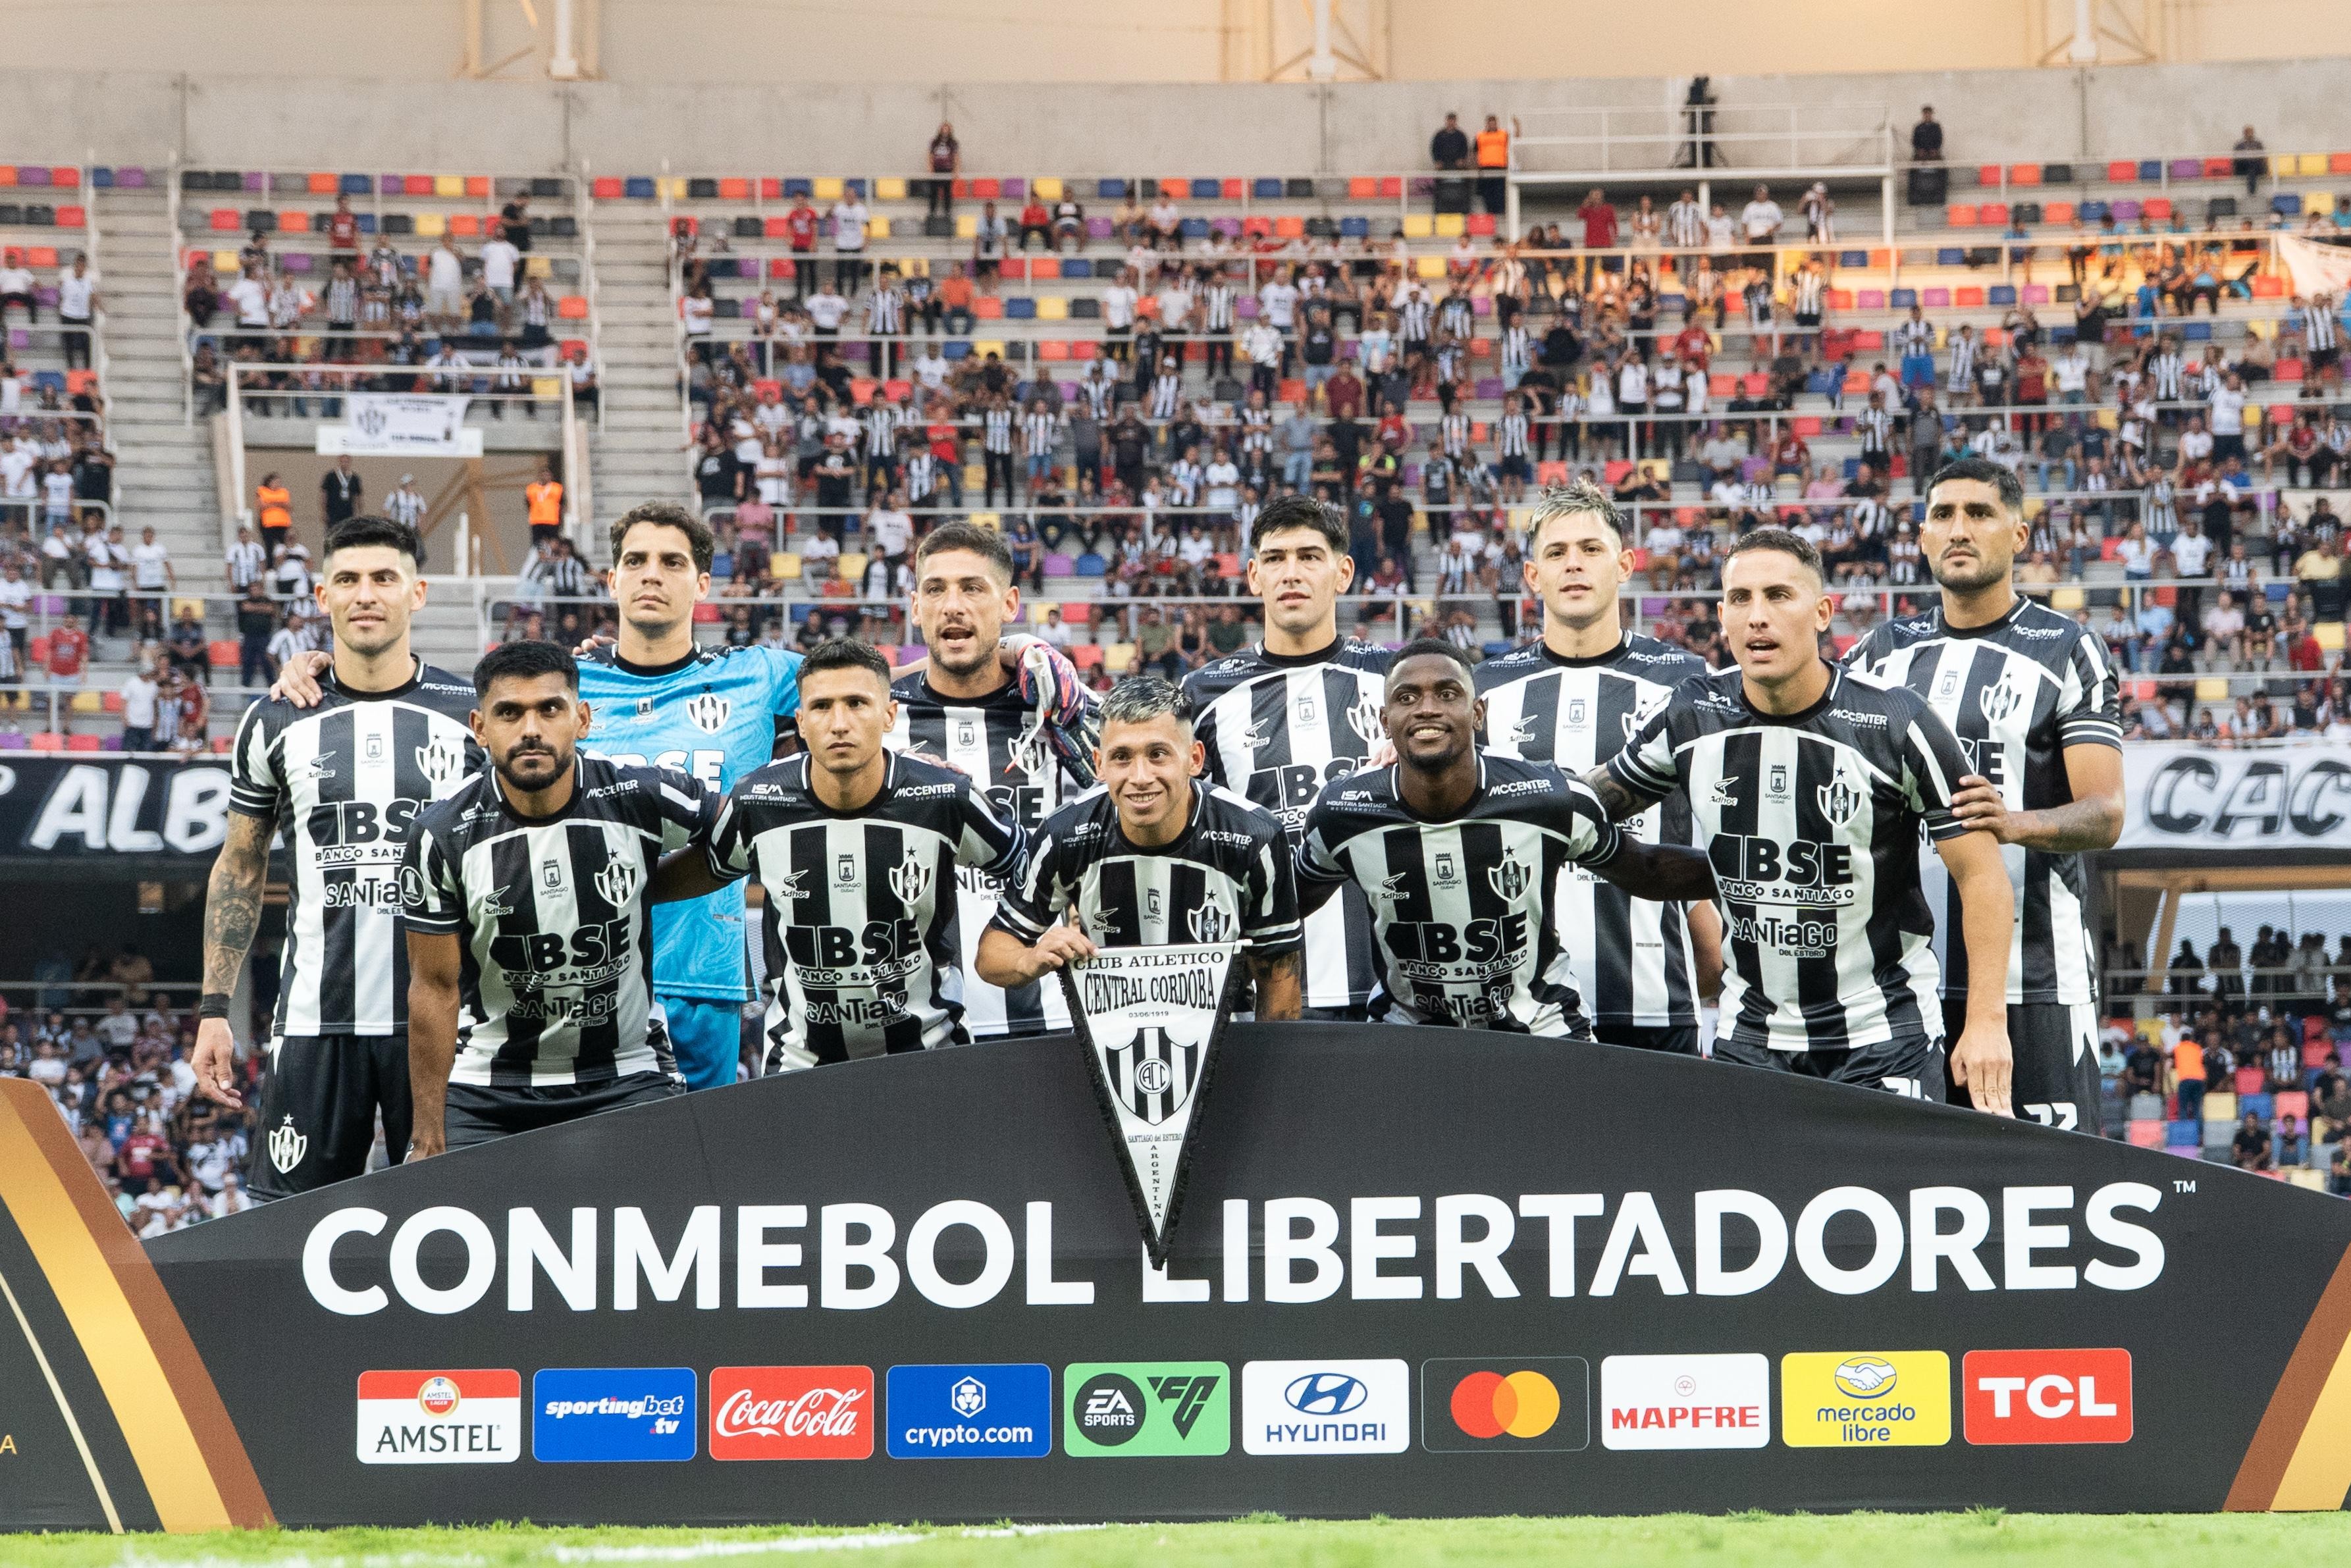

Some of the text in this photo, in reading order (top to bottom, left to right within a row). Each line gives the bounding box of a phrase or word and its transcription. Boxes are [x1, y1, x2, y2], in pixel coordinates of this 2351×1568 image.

[1828, 708, 1888, 725] MCCENTER
[751, 783, 784, 796] ISM
[893, 783, 956, 798] MCCENTER
[1341, 791, 1373, 802] ISM
[1489, 779, 1552, 797] MCCENTER
[1511, 787, 1554, 798] DEPORTES
[1709, 795, 1738, 806] Adhoc
[315, 848, 363, 862] BANCO
[1745, 835, 1854, 887] BSE
[780, 890, 810, 899] Adhoc
[1381, 891, 1410, 900] Adhoc
[1720, 881, 1855, 902] BANCO SANTIAGO
[485, 906, 514, 915] Adhoc
[1092, 924, 1121, 933] Adhoc
[1421, 909, 1527, 963] BSE
[529, 912, 631, 972] BSE
[818, 914, 922, 968] BSE
[558, 954, 631, 981] SANTIAGO
[795, 954, 921, 982] BANCO SANTIAGO
[1073, 952, 1225, 970] CLUB ATLETICO
[1399, 949, 1527, 977] BANCO SANTIAGO
[1085, 967, 1217, 1017] CENTRAL CORDOBA
[1128, 1134, 1153, 1143] SANTIAGO
[1163, 1133, 1182, 1141] ESTERO
[1150, 1144, 1162, 1218] ARGENTINA
[302, 1199, 1096, 1316] CONMEBOL
[1085, 1389, 1134, 1413] EA
[1978, 1374, 2117, 1419] TCL
[546, 1395, 685, 1419] sportingbet
[716, 1388, 866, 1438] Coca-Cola
[1817, 1403, 1916, 1422] mercado
[649, 1418, 679, 1434] .tv
[1084, 1413, 1135, 1427] SPORTS
[1612, 1405, 1760, 1429] MAPFRE
[375, 1424, 502, 1453] AMSTEL
[905, 1424, 1033, 1447] crypto.com
[1267, 1423, 1386, 1442] HYUNDAI
[1842, 1424, 1891, 1442] libre
